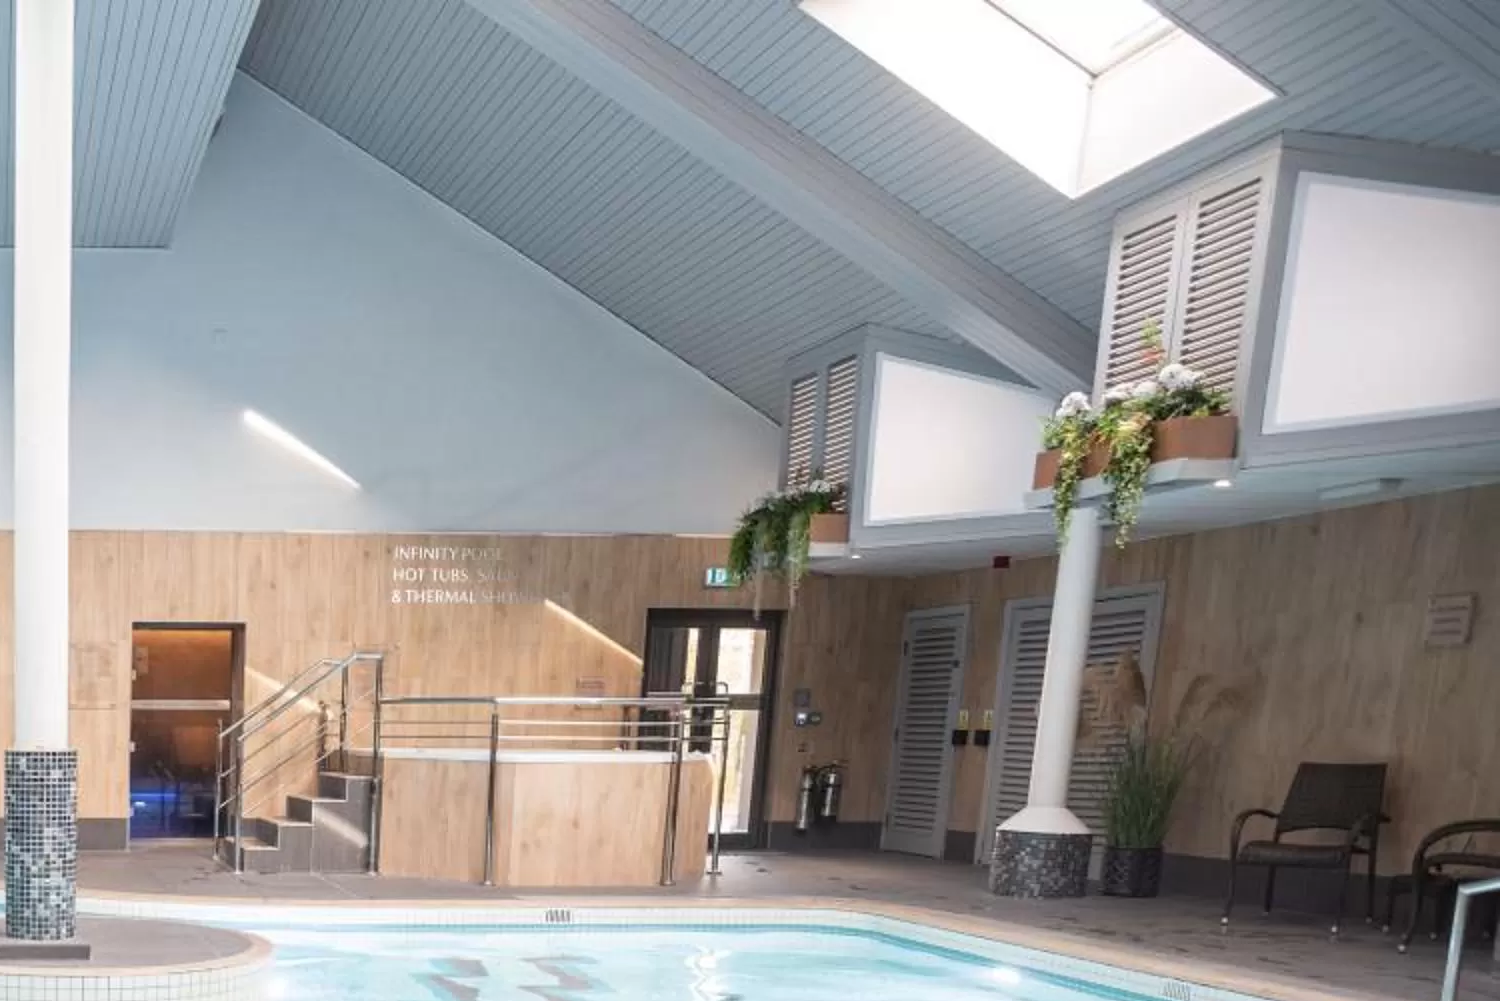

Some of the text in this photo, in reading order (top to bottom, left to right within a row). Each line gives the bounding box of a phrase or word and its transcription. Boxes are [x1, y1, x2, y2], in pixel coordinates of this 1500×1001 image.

[394, 546, 459, 561] INFINITY
[392, 567, 426, 582] HOT
[390, 589, 402, 604] &
[404, 589, 476, 604] THERMAL
